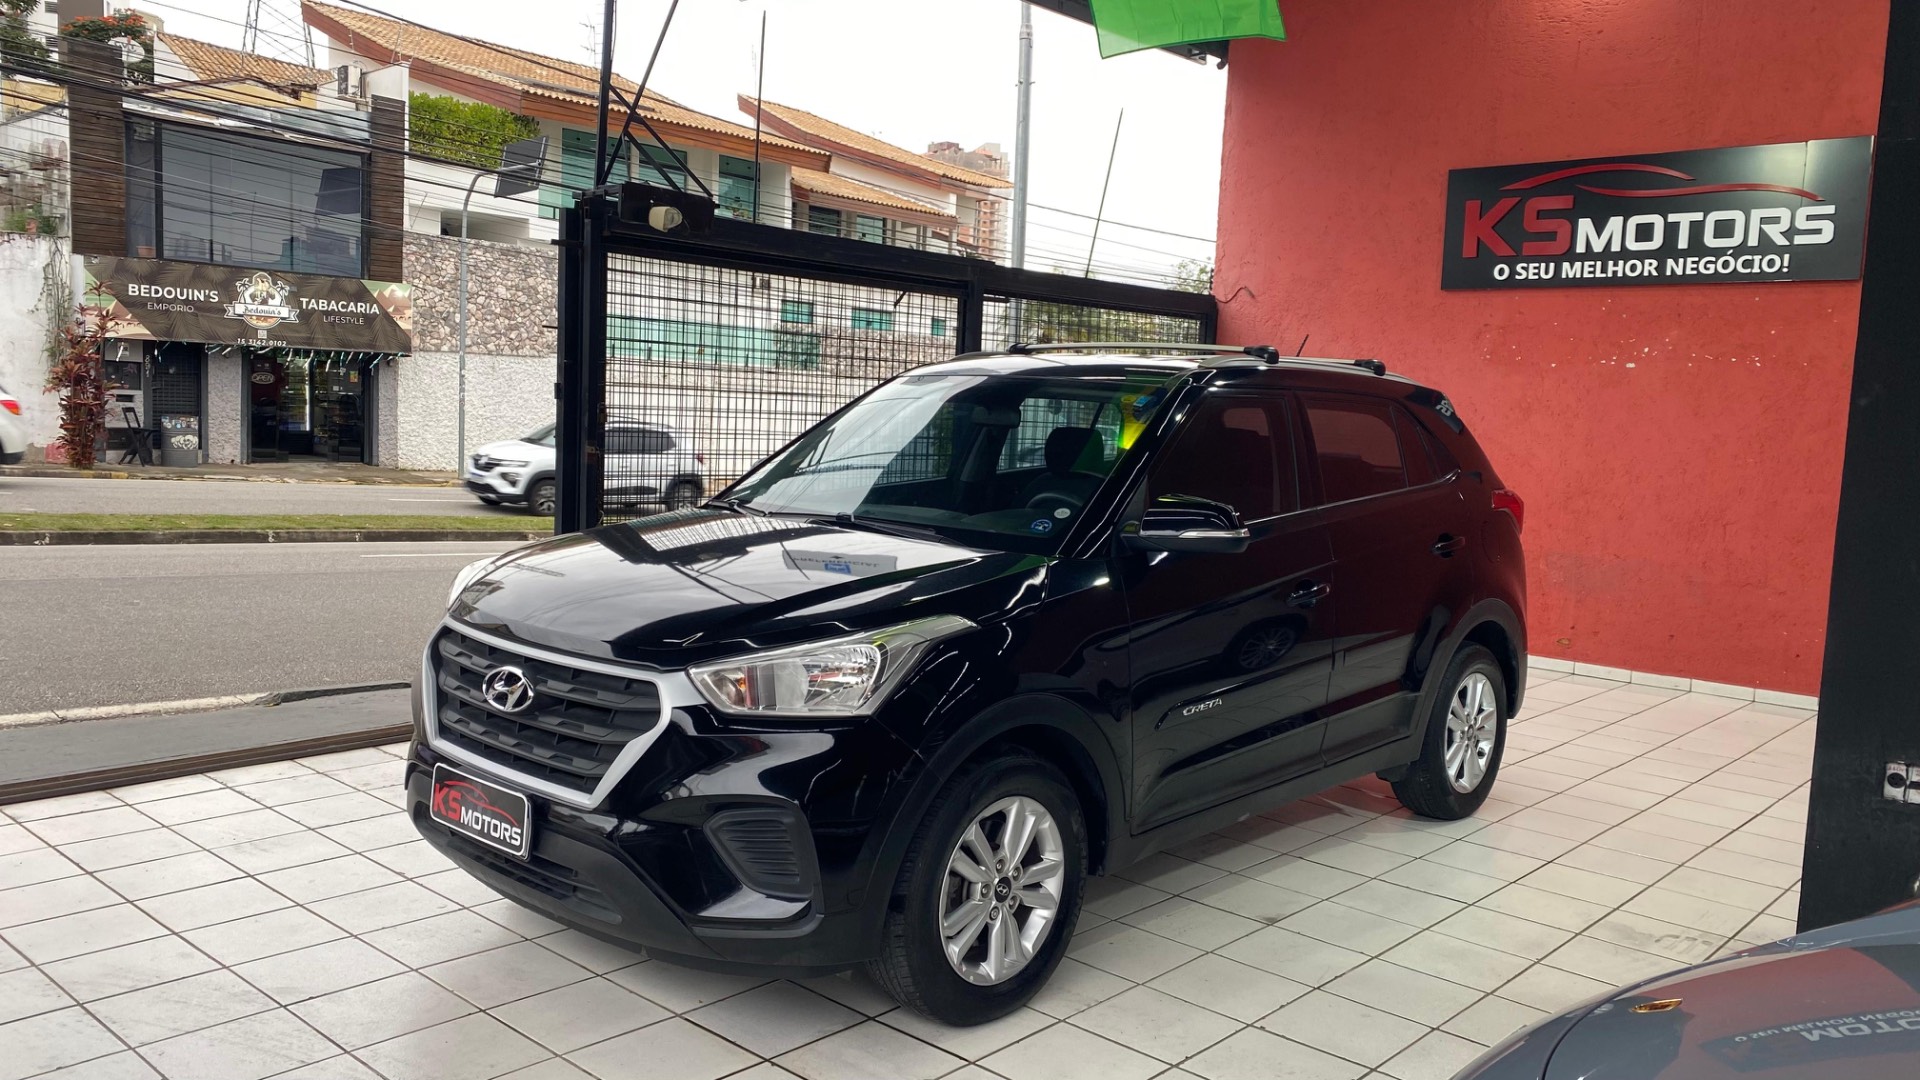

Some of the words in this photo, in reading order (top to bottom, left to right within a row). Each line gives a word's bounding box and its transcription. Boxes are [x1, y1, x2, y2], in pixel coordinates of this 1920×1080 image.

[1493, 263, 1511, 281] O
[1515, 262, 1556, 280] SEU
[1561, 259, 1659, 279] MELHOR
[1665, 249, 1791, 276] NEGÓCIO!
[128, 283, 219, 303] BEDOUIN'S
[147, 302, 195, 313] EMPORIO
[299, 298, 380, 315] TABACARIA
[323, 315, 365, 325] LIFESTYLE
[1182, 698, 1222, 716] CRETA
